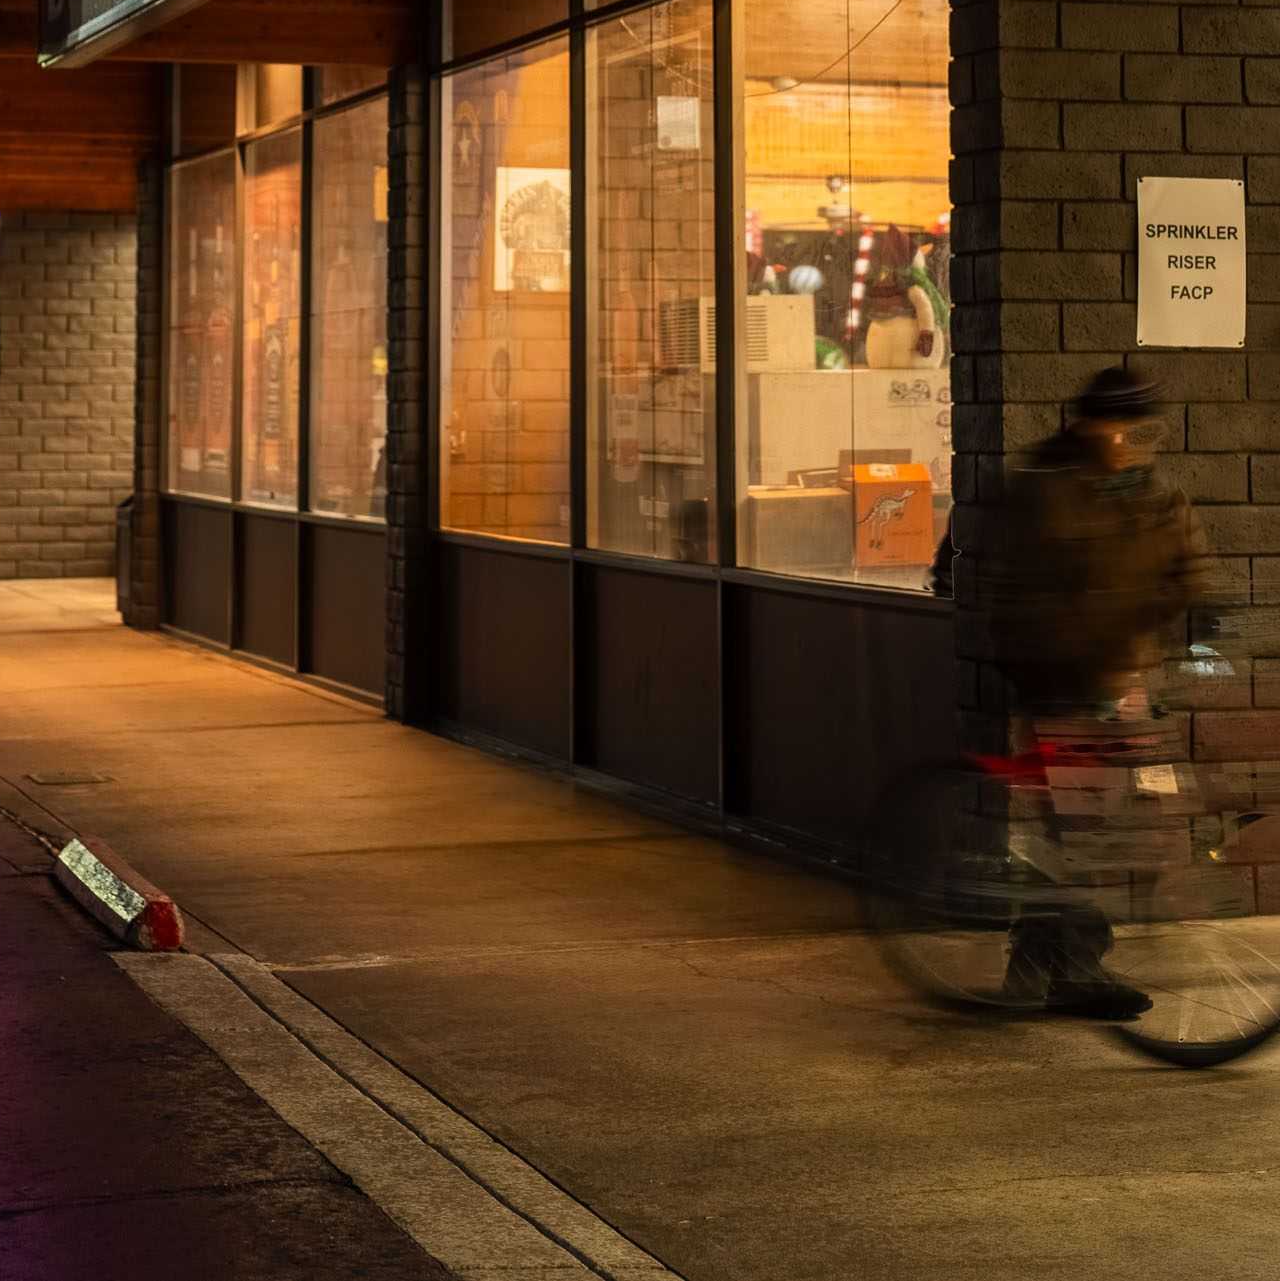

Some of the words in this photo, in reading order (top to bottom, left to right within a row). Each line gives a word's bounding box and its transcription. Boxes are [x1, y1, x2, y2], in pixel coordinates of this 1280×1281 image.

[1146, 224, 1238, 240] SPRINKLER
[1168, 255, 1216, 269] RISER
[1171, 286, 1213, 299] FACP
